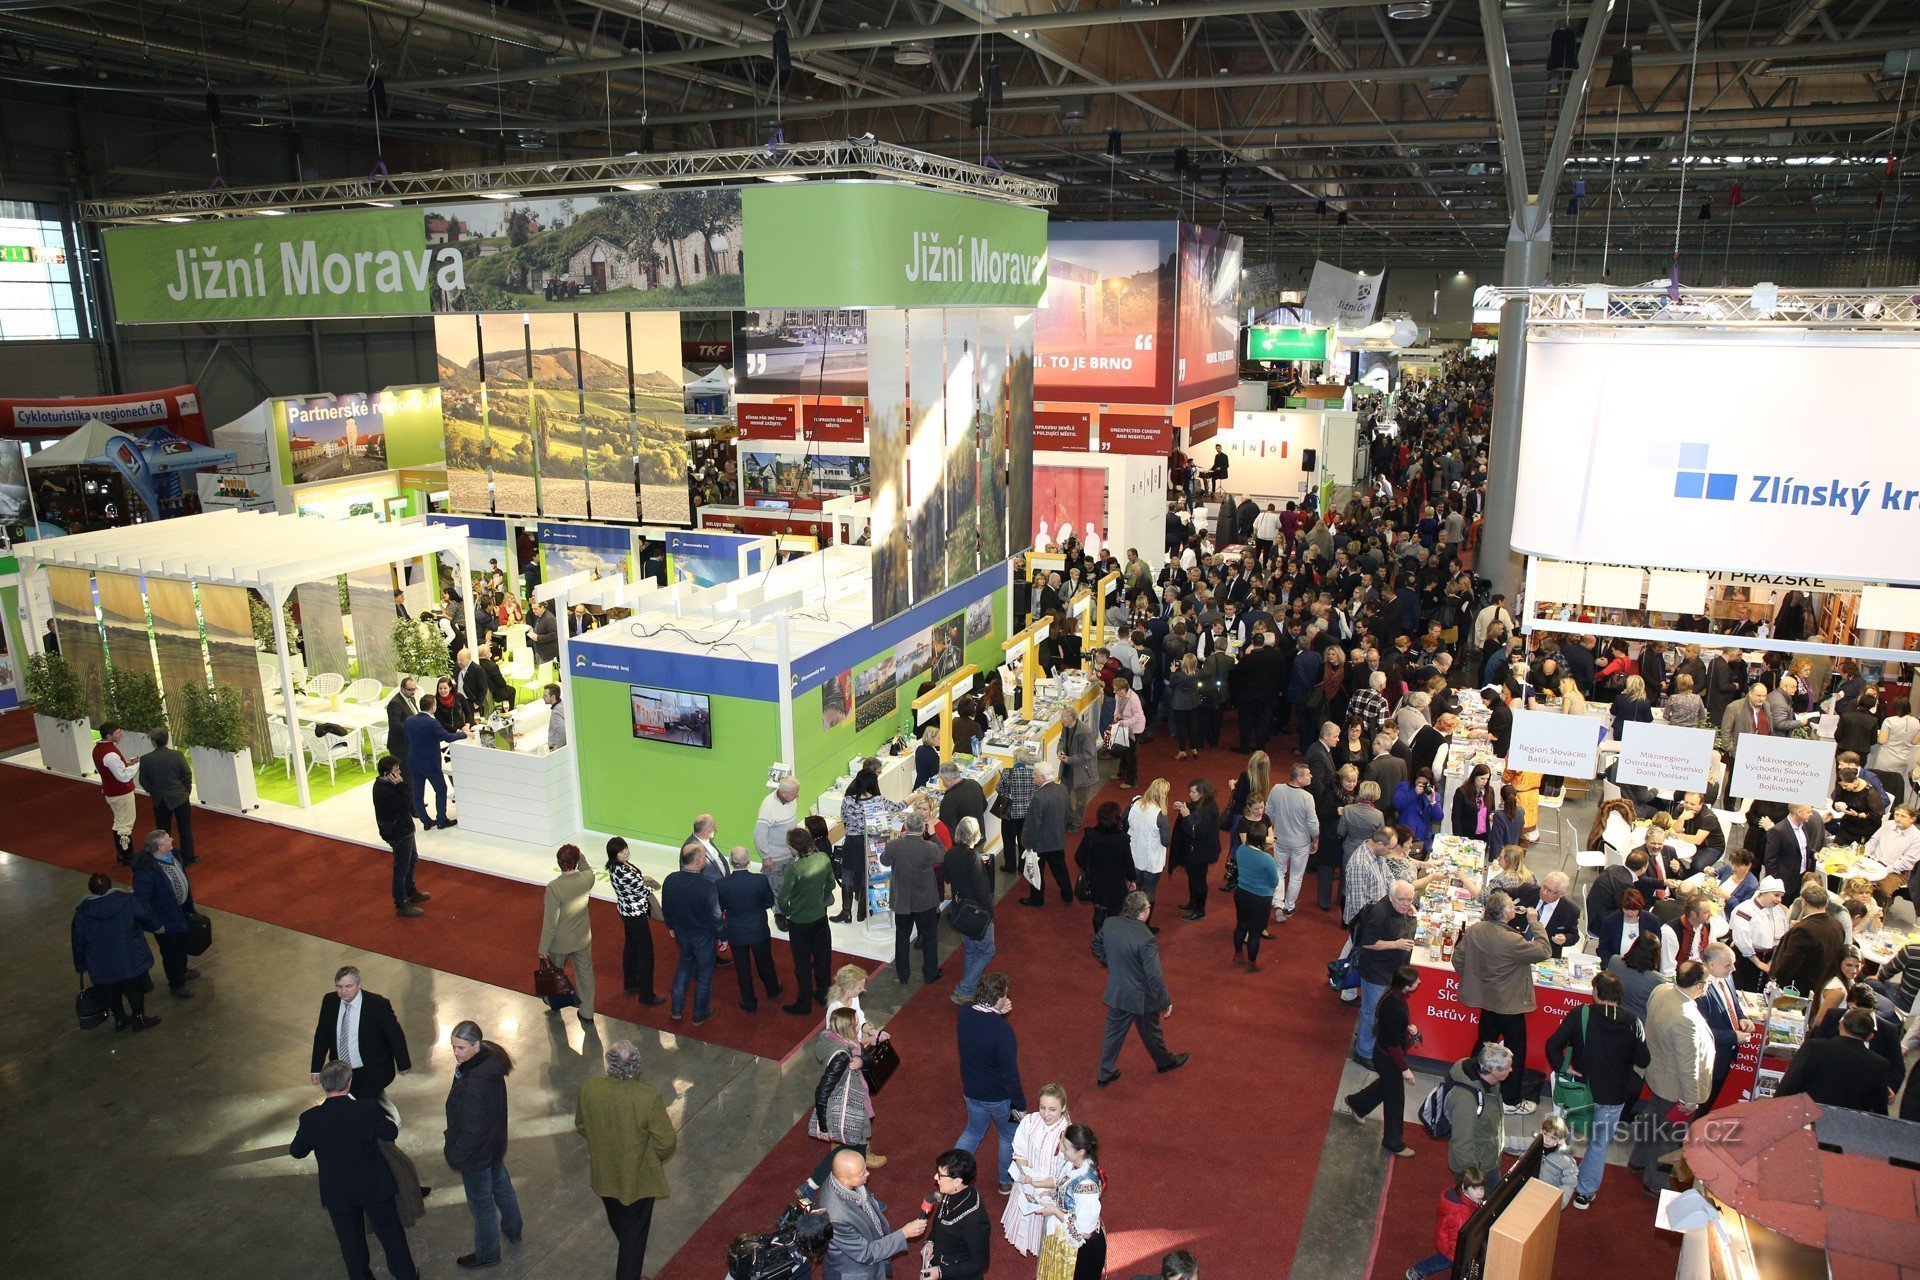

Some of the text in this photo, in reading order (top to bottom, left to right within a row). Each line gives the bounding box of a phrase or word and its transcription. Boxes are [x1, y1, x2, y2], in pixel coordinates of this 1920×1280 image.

[905, 231, 1042, 286] Jižní Morava
[167, 240, 466, 301] Jižní Morava
[699, 345, 727, 356] TKF
[1050, 355, 1069, 369] TO
[1072, 356, 1086, 371] JE
[1090, 357, 1133, 370] BRNO
[18, 402, 163, 425] Cykloturistika v regionech ČR
[289, 400, 369, 424] Partnerské
[1749, 475, 1920, 516] Zlínský kr
[1519, 743, 1587, 759] Region Slovácko
[1640, 751, 1691, 764] Mikroregiony
[1527, 754, 1576, 767] Baťův kanál
[1624, 758, 1662, 769] Ostrožsko
[1671, 763, 1704, 774] Veselsko
[1757, 755, 1811, 769] Mikroregiony
[1745, 763, 1820, 778] Východní Slovácko
[1756, 773, 1805, 785] Bílé Karpaty
[1759, 782, 1799, 793] Bojkovsko
[1427, 1005, 1466, 1022] Baťův
[1730, 1063, 1754, 1073] vsko
